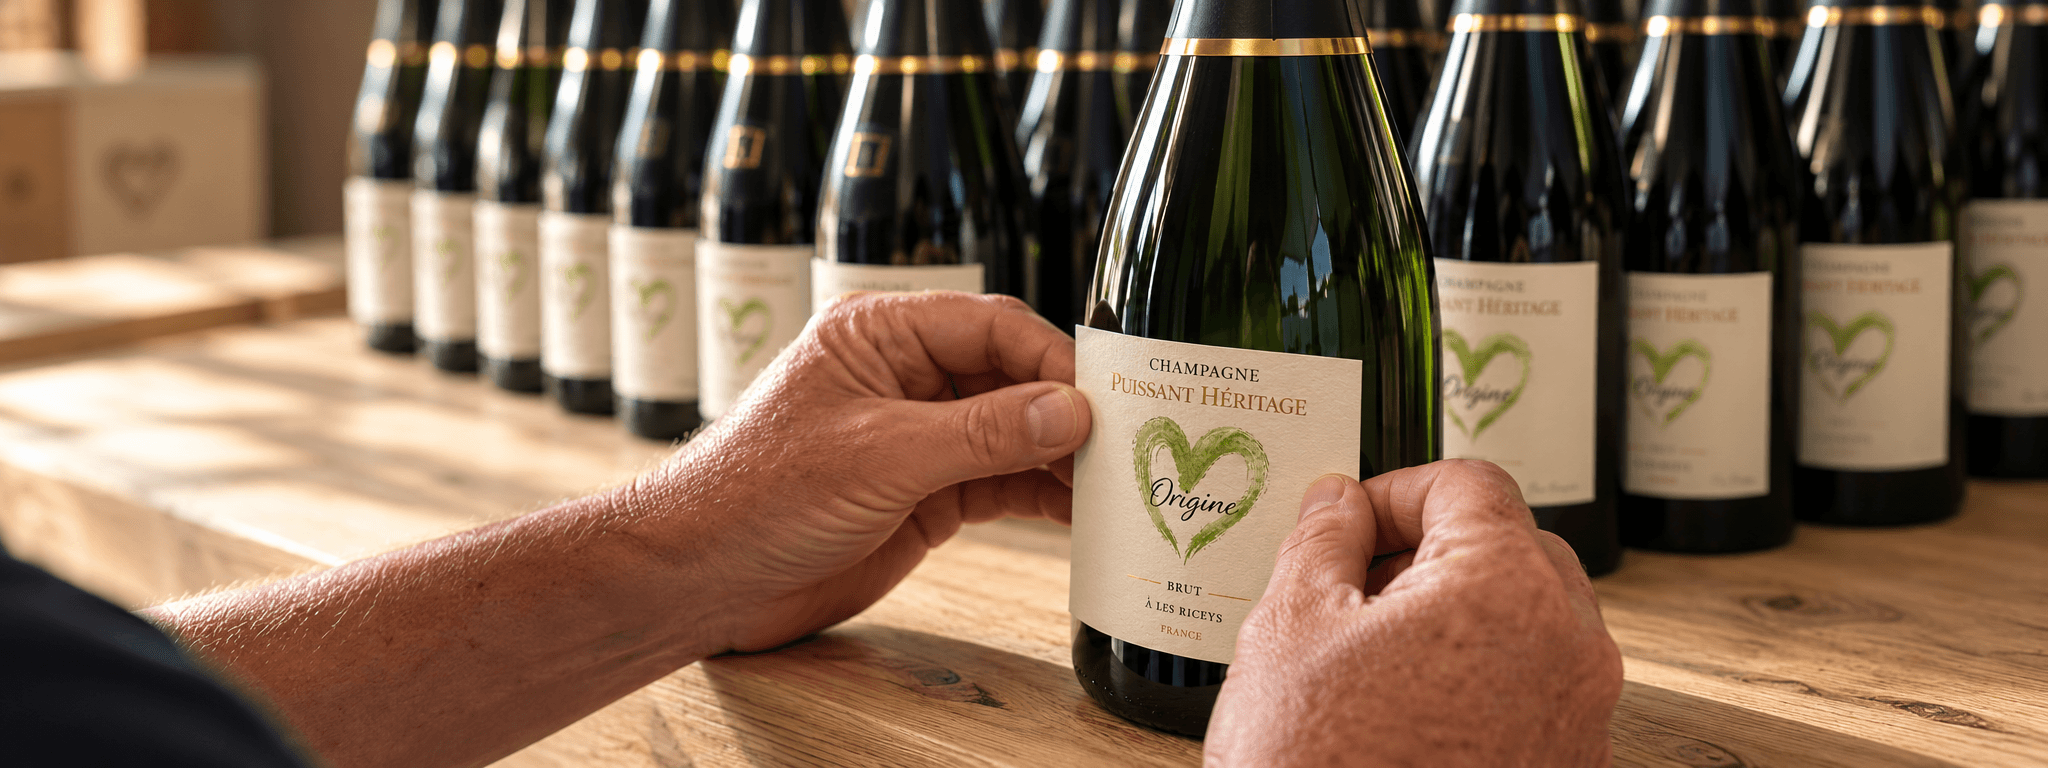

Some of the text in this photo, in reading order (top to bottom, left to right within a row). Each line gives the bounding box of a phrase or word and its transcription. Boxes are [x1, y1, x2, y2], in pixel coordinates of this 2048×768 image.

[1149, 357, 1260, 383] CHAMPAGNE
[1111, 371, 1307, 416] PUISSANT HÉRITAGE
[1150, 477, 1240, 521] Origine
[1167, 580, 1202, 596] BRUT
[1156, 601, 1175, 613] LES
[1179, 606, 1223, 623] RICEYS
[1160, 624, 1202, 641] FRANCE
